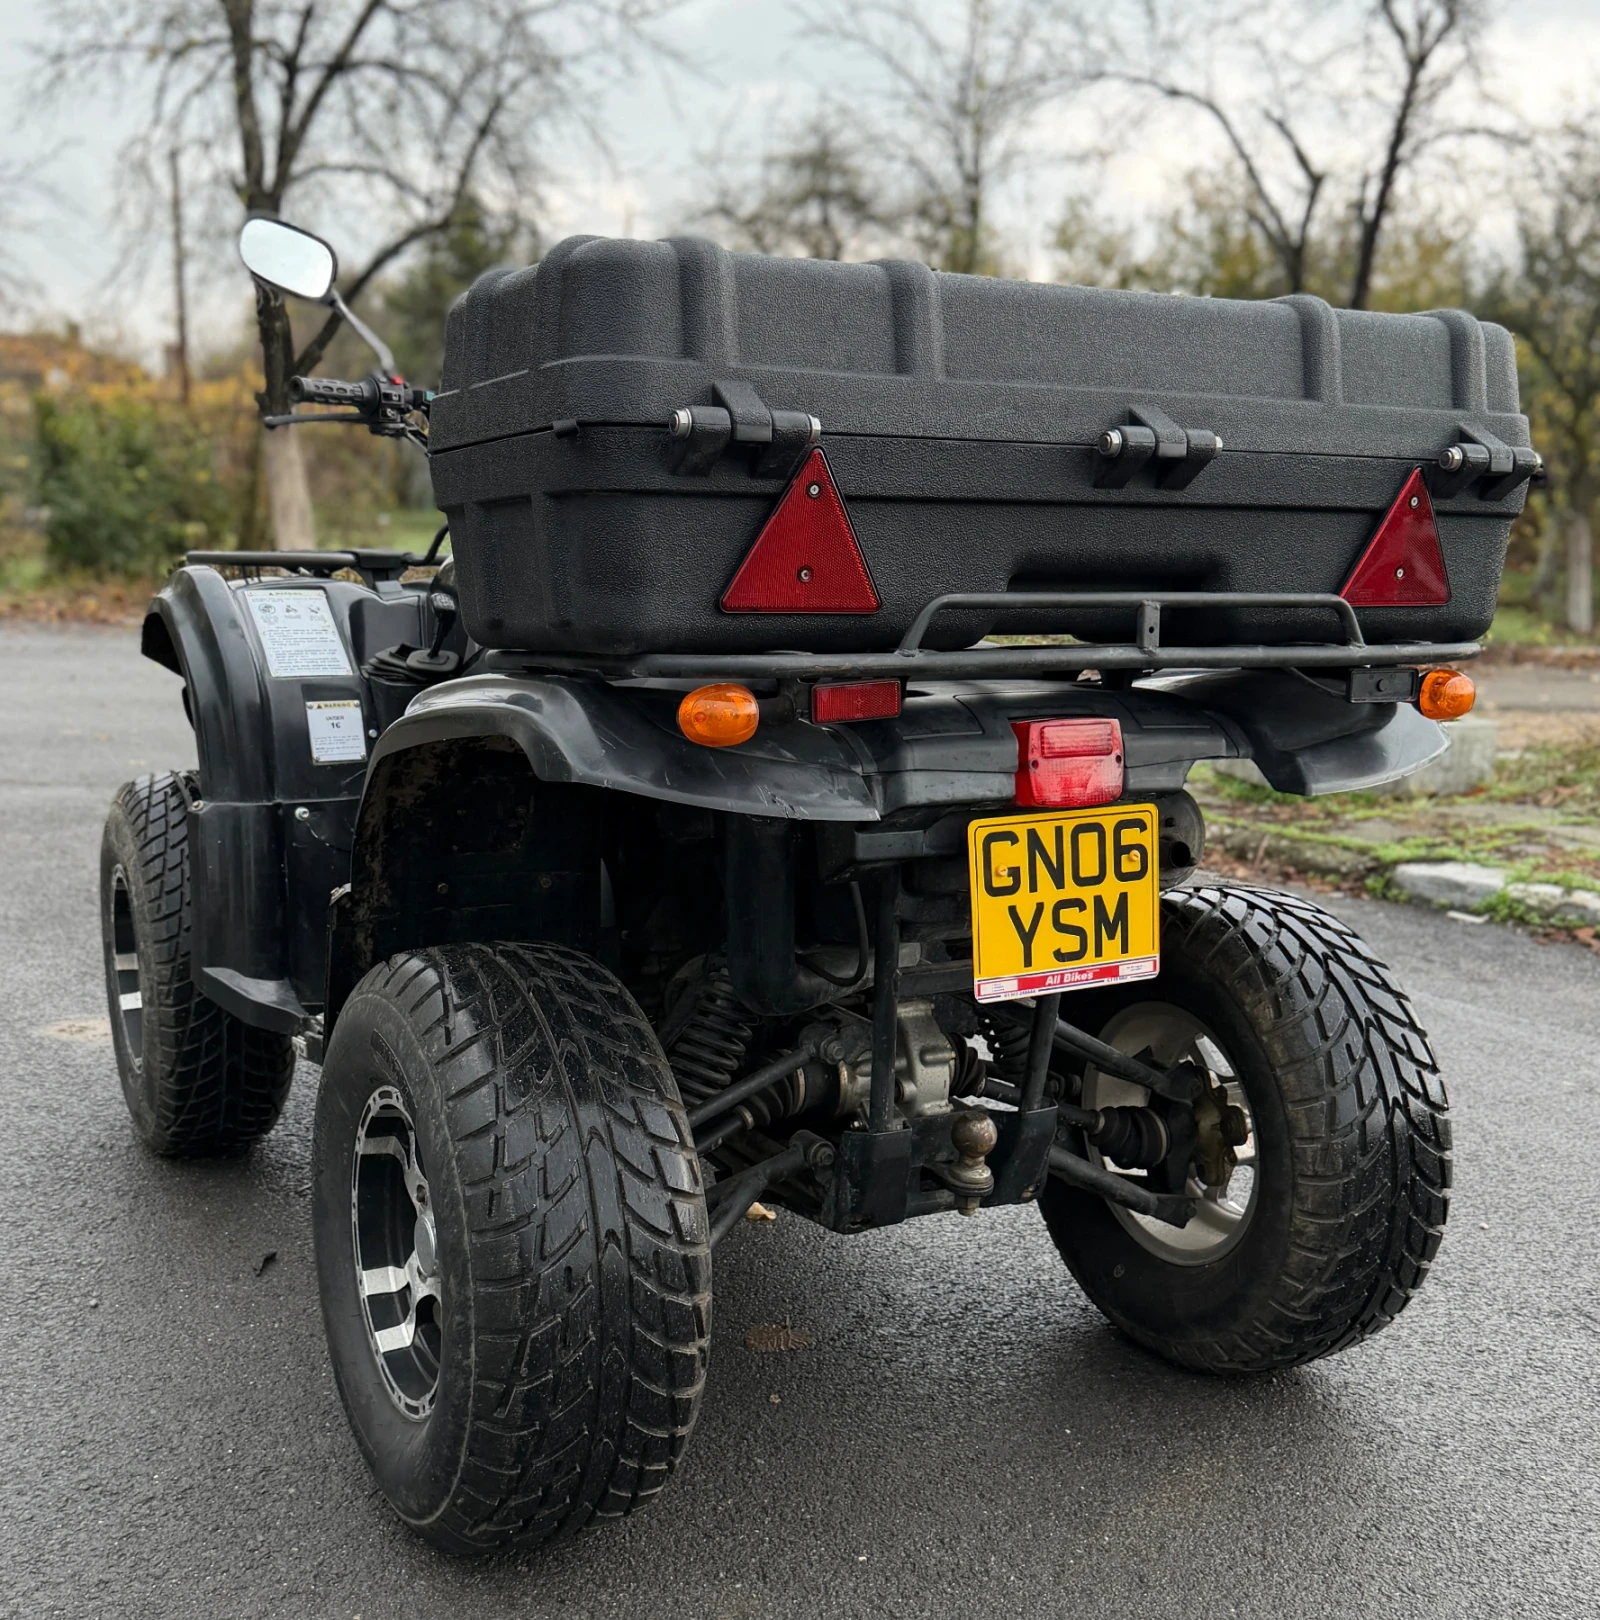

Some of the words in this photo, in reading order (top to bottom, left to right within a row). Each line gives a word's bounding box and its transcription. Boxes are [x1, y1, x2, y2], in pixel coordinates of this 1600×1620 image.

[1007, 891, 1129, 968] YSM
[1045, 974, 1061, 986] All
[1063, 971, 1094, 984] Bikes
